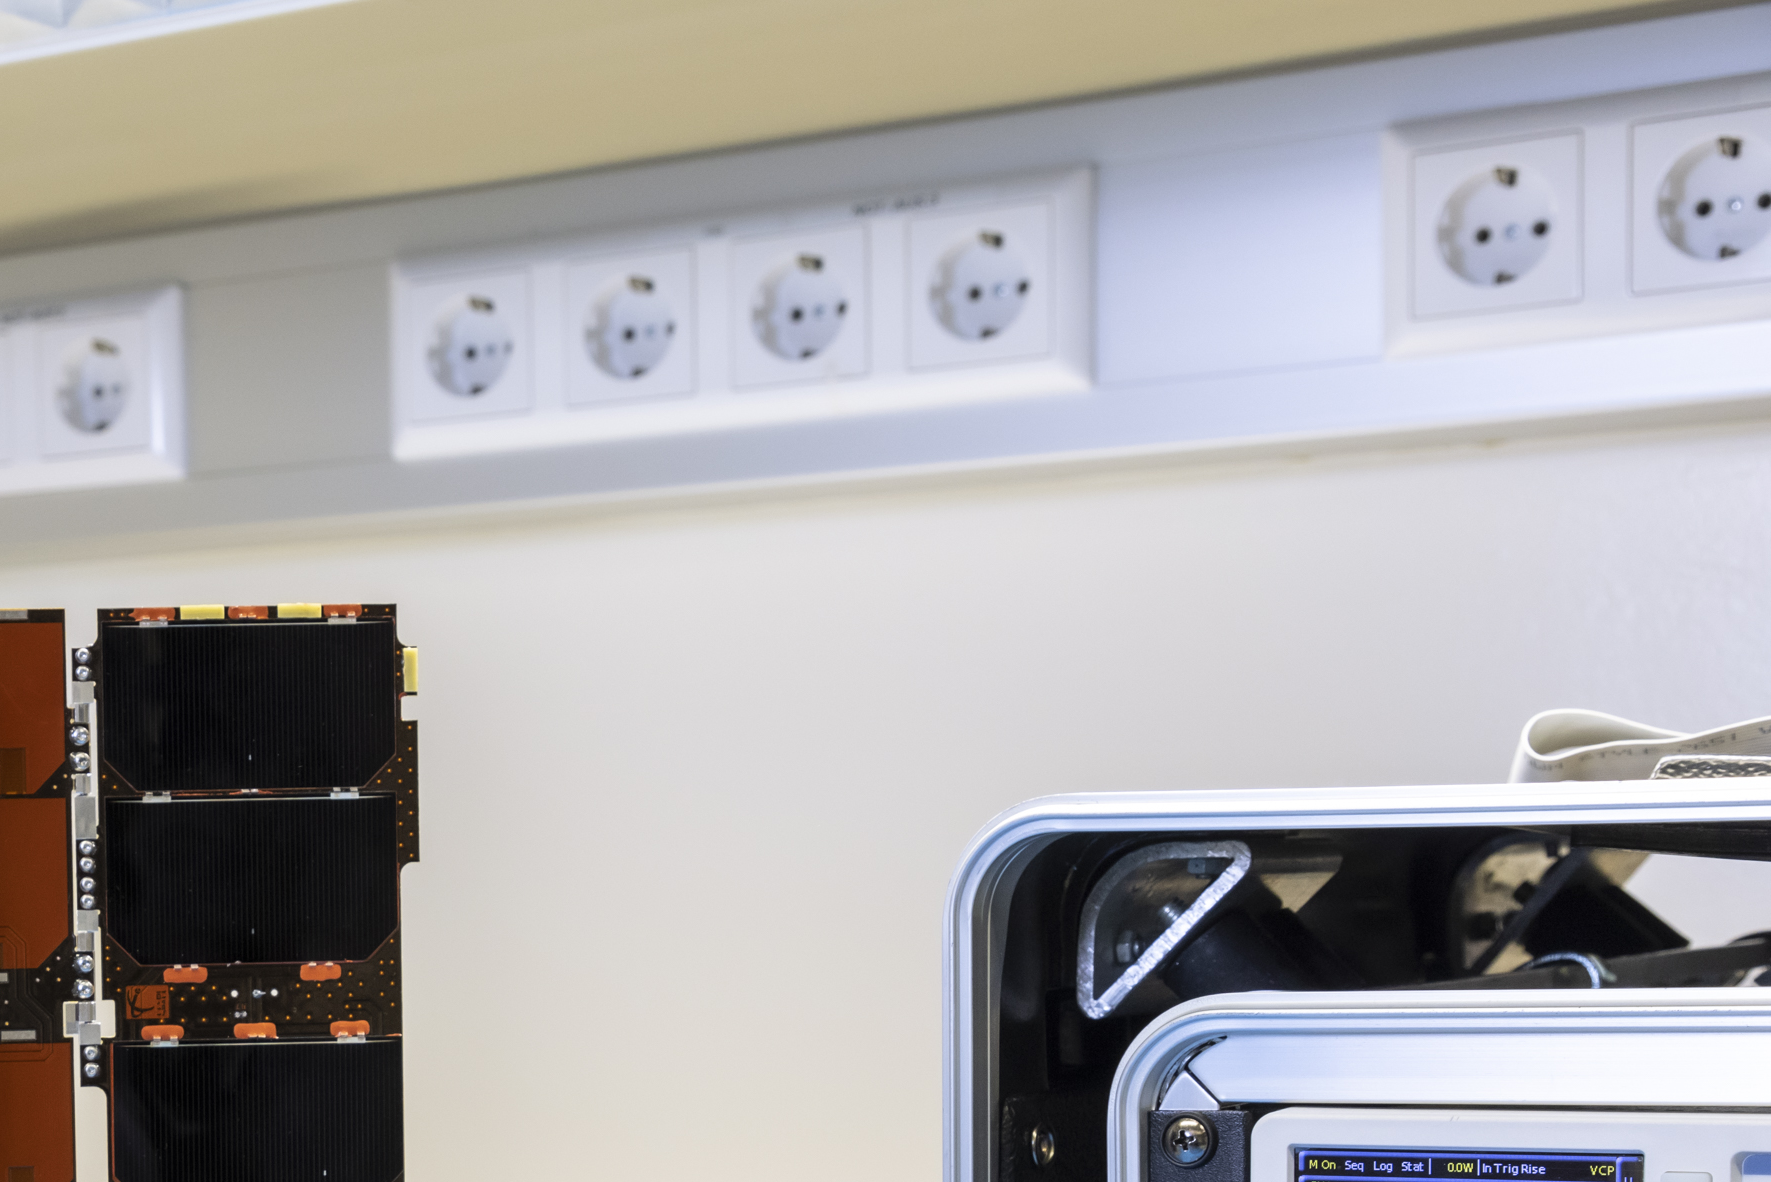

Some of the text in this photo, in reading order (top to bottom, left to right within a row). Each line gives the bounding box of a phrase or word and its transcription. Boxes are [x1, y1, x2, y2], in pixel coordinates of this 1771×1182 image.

[1308, 1159, 1615, 1176] M On Seq Log Stat 0.0W In Trig Rise VCP
